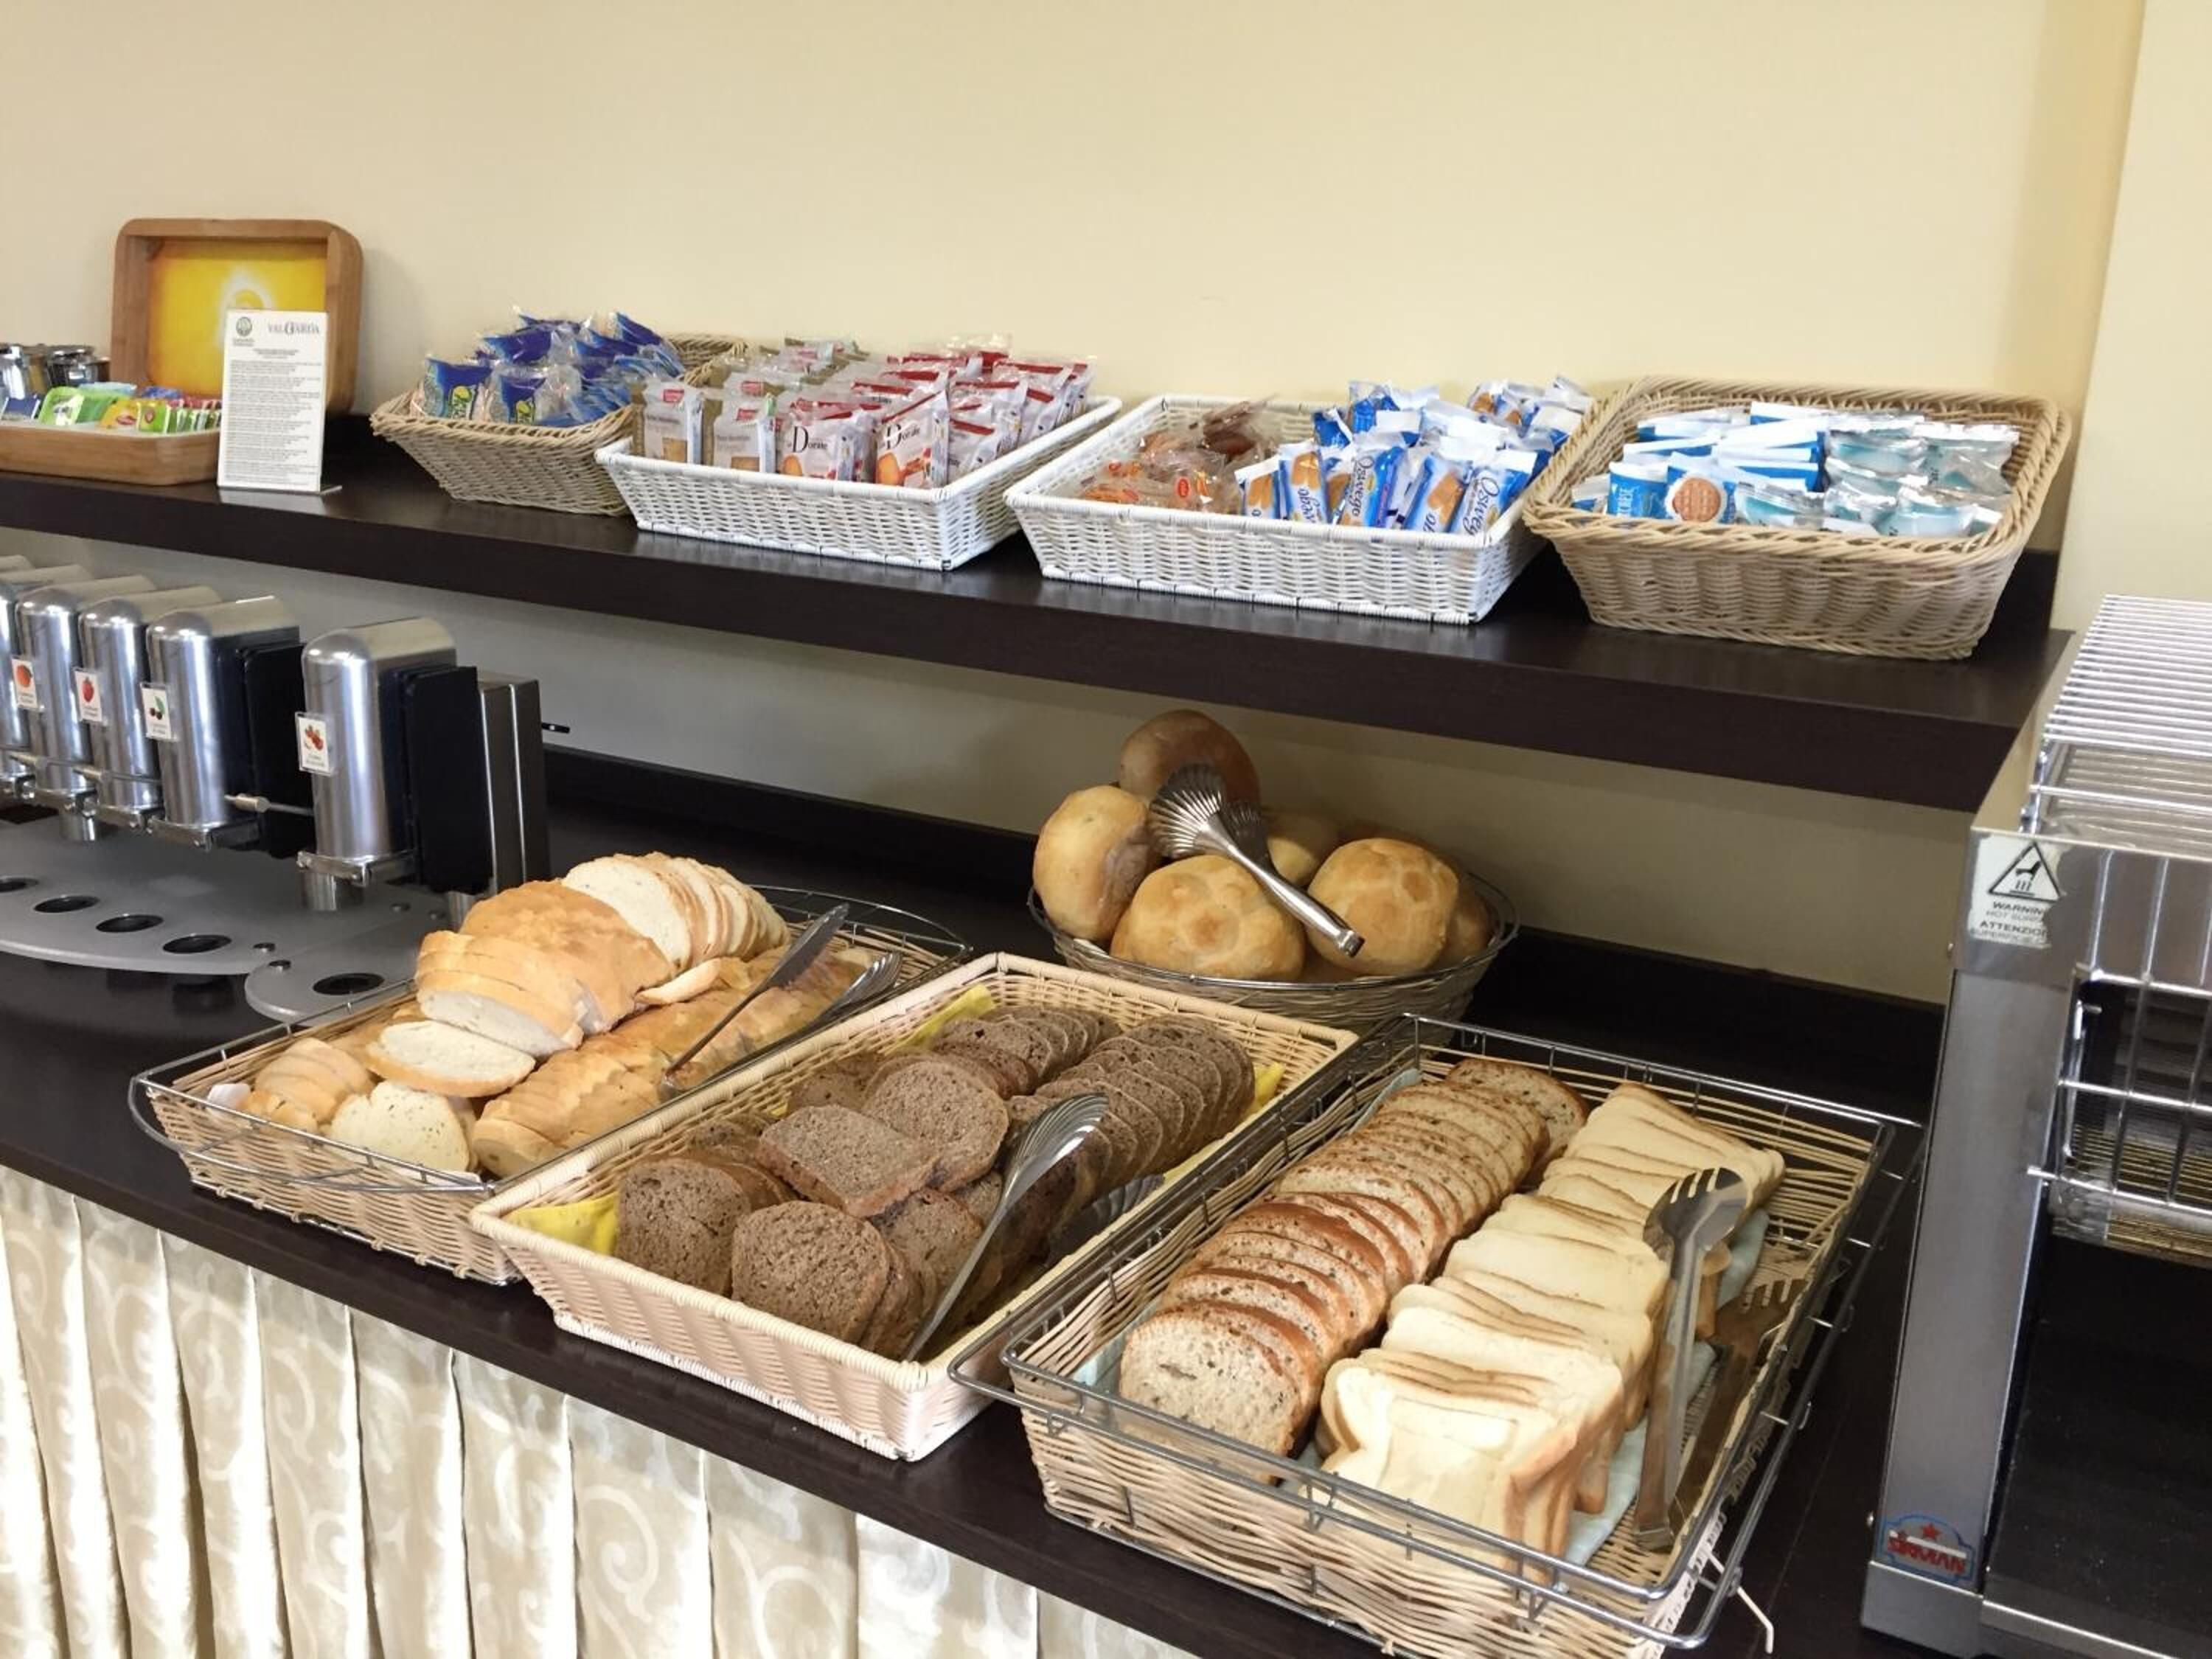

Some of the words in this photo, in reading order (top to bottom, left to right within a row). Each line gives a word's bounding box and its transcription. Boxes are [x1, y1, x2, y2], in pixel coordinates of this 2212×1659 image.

[1349, 456, 1374, 516] Oswego
[1463, 477, 1500, 535] Osweg
[1993, 902, 2042, 914] WARNIN
